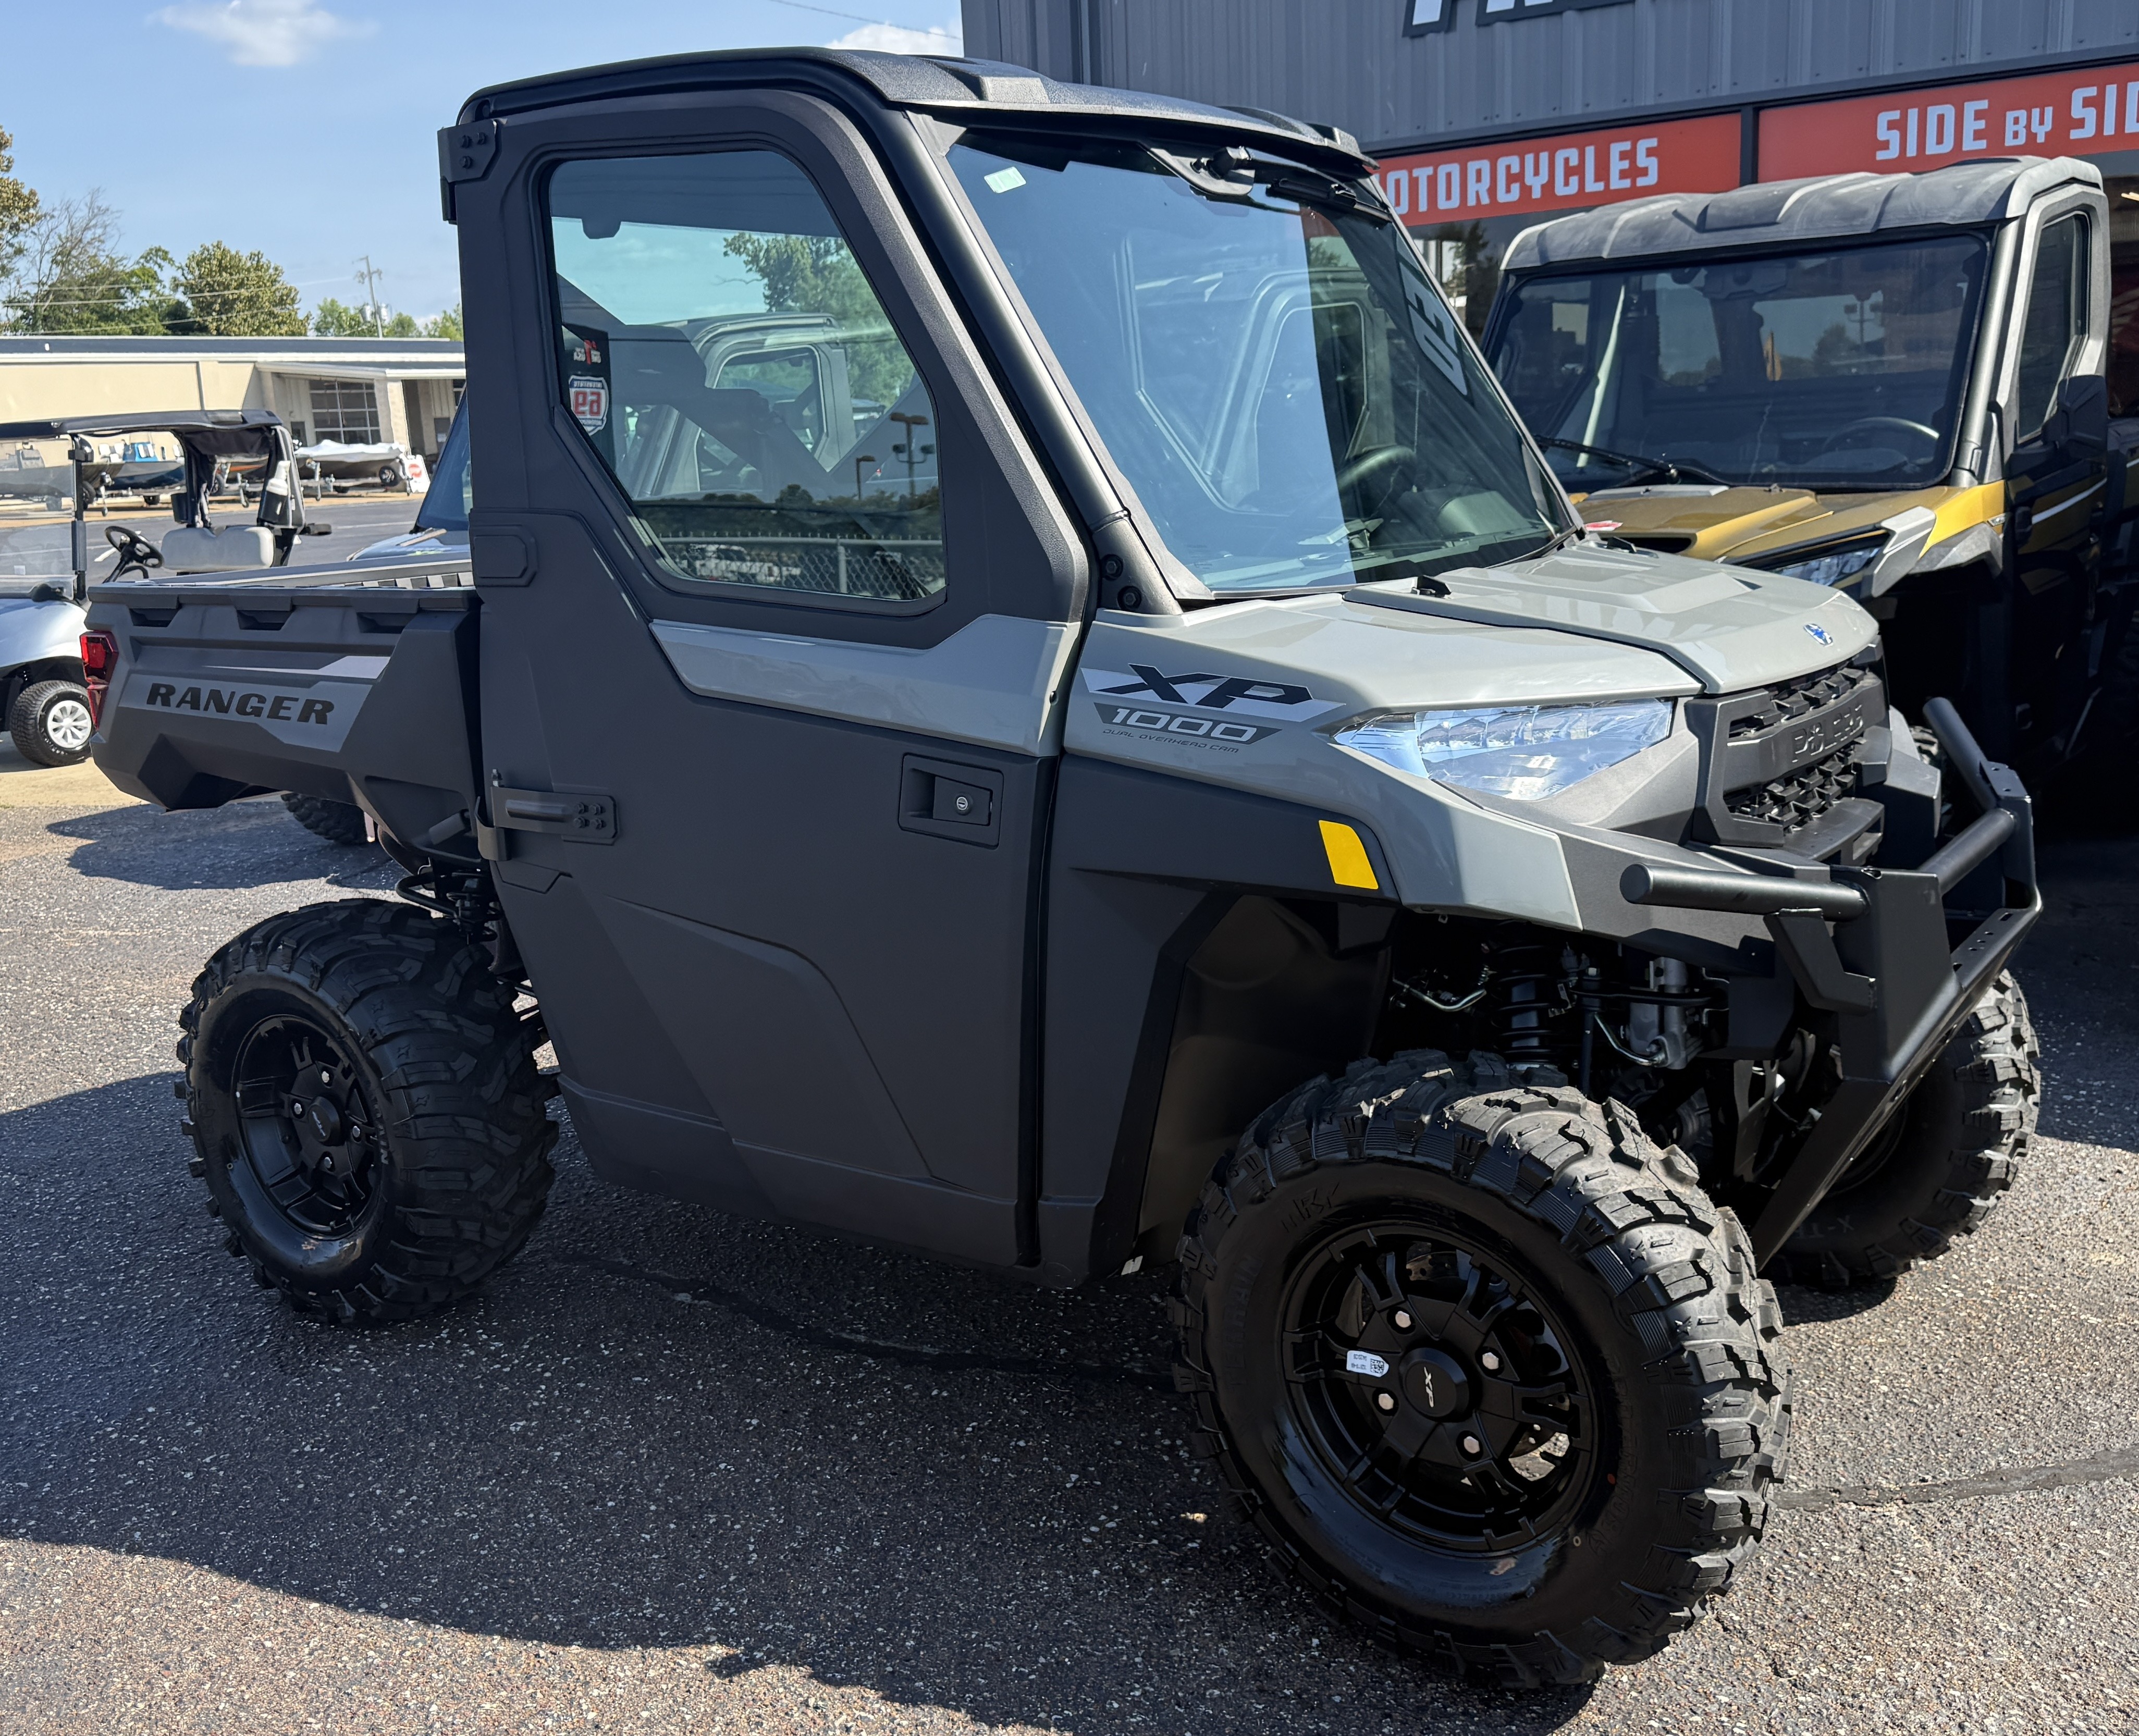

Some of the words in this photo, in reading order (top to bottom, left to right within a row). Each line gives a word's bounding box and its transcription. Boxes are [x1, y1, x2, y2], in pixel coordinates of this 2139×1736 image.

[1876, 99, 1988, 160] SIDE
[2005, 106, 2052, 146] BY
[1375, 137, 1658, 216] OTORCYCLES
[146, 682, 335, 725] RANGER
[1095, 663, 1313, 709] XP
[1102, 729, 1134, 738] DUAL
[1139, 734, 1208, 748] OVERHEAD
[1209, 744, 1240, 754] CAM
[1111, 707, 1258, 742] 1000
